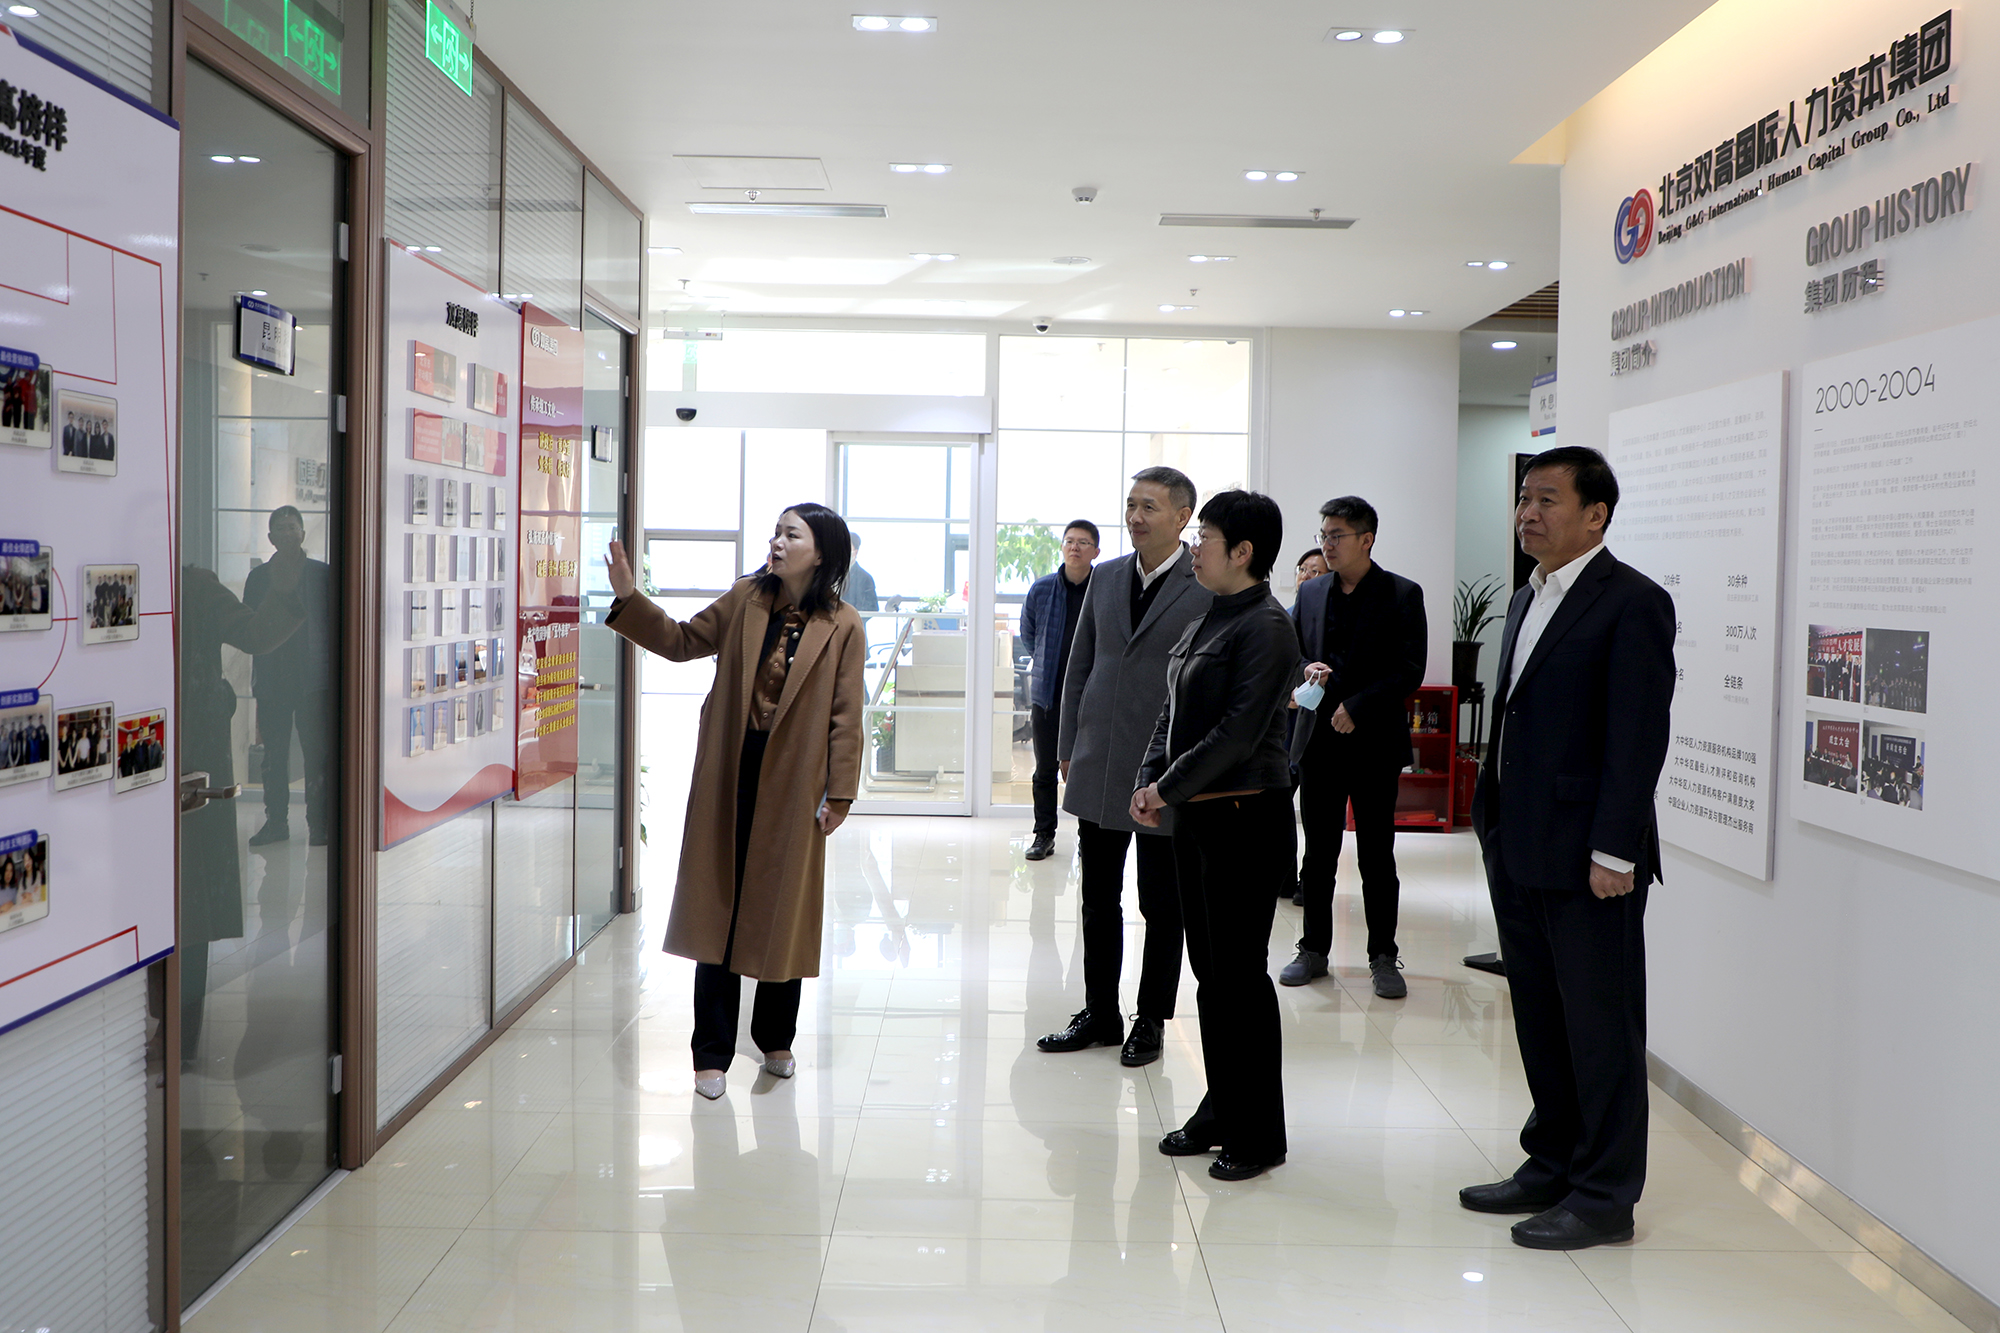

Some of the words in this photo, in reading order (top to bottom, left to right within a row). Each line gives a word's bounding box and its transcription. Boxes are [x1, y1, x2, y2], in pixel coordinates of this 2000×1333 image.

[1658, 9, 1953, 218] 北京双高国际人力资本集团
[1658, 225, 1682, 244] Beijing
[1685, 210, 1704, 230] G&G
[1708, 179, 1762, 220] International
[1768, 165, 1802, 191] Human
[1808, 138, 1846, 170] Capital
[1852, 122, 1888, 149] Group
[1928, 85, 1950, 113] Ltd
[1805, 205, 1871, 267] GROUP
[1875, 163, 1973, 243] HISTORY
[1611, 299, 1648, 341] GROUP
[1650, 257, 1746, 327] INTRODUCTION
[1804, 258, 1881, 314] 集团历程
[1610, 340, 1656, 376] 集团简介
[1540, 393, 1557, 411] 休息
[1815, 363, 1936, 414] 2000-2004
[1725, 625, 1757, 640] 300万人次
